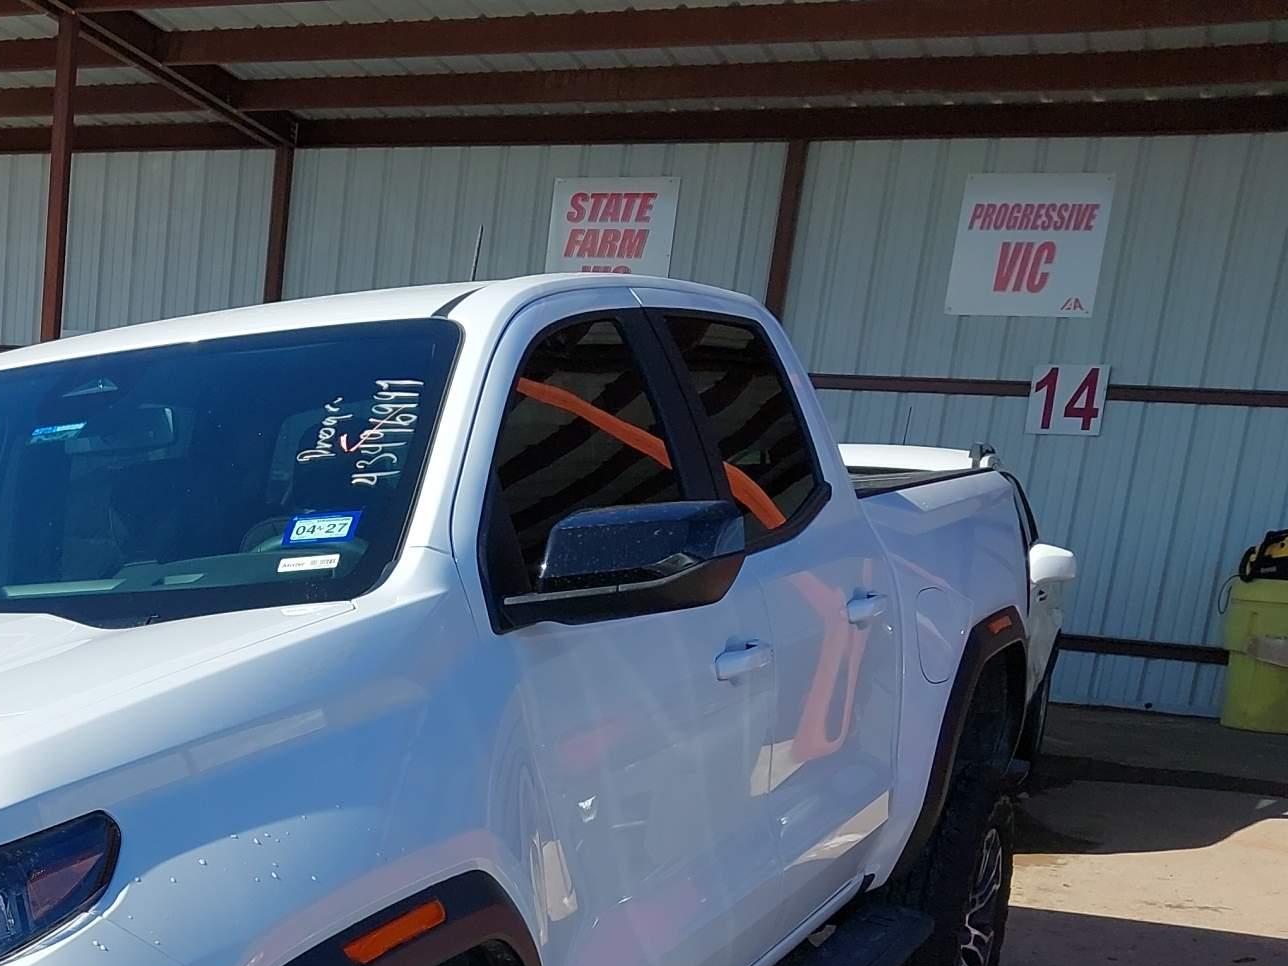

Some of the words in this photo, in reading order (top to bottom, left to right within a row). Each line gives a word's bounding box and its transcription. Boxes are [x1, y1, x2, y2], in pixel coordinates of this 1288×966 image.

[566, 192, 658, 223] STATE
[968, 203, 1101, 231] PROGRESSIVE
[563, 228, 650, 258] FARM
[993, 241, 1056, 294] VIC
[1034, 366, 1101, 431] 14
[295, 524, 317, 536] 04
[324, 522, 349, 535] 27
